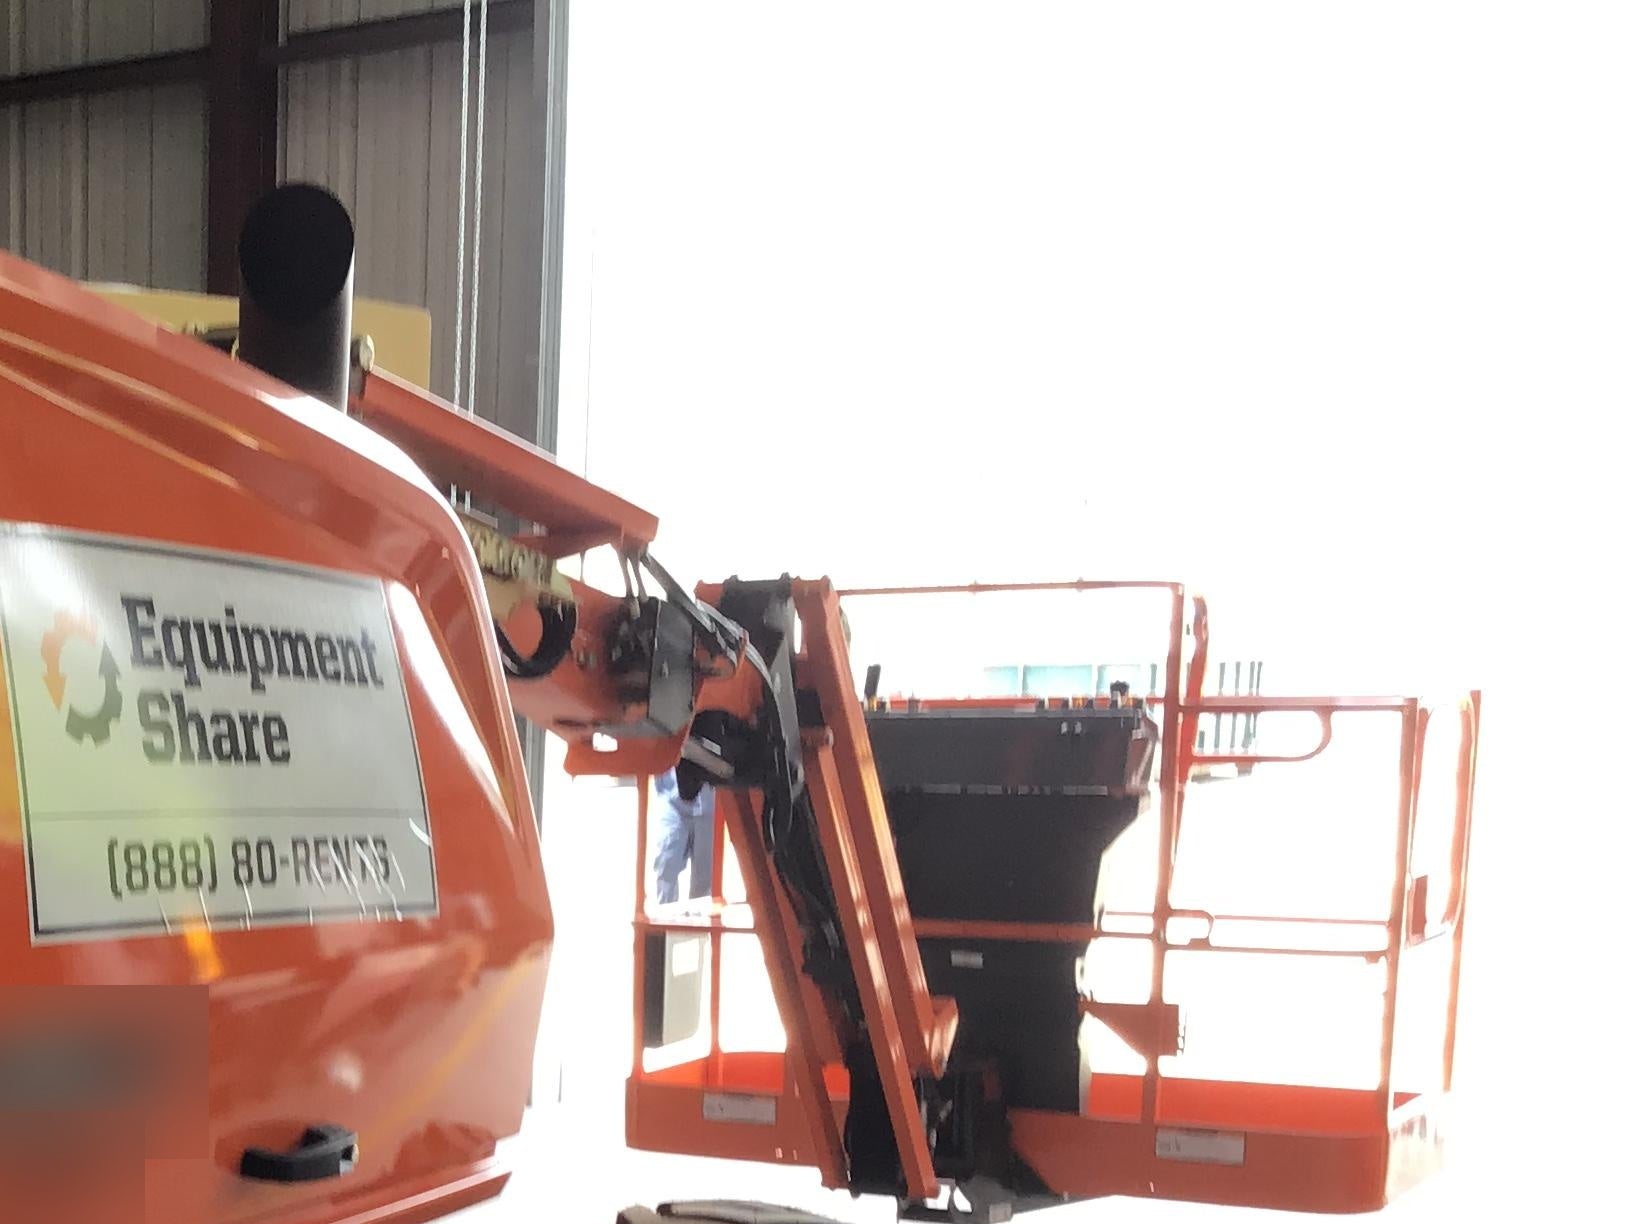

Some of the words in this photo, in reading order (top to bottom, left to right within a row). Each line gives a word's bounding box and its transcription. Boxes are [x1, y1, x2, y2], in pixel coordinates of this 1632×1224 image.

[121, 593, 384, 694] Equipment
[137, 689, 291, 766] Share
[107, 833, 217, 901] (888)
